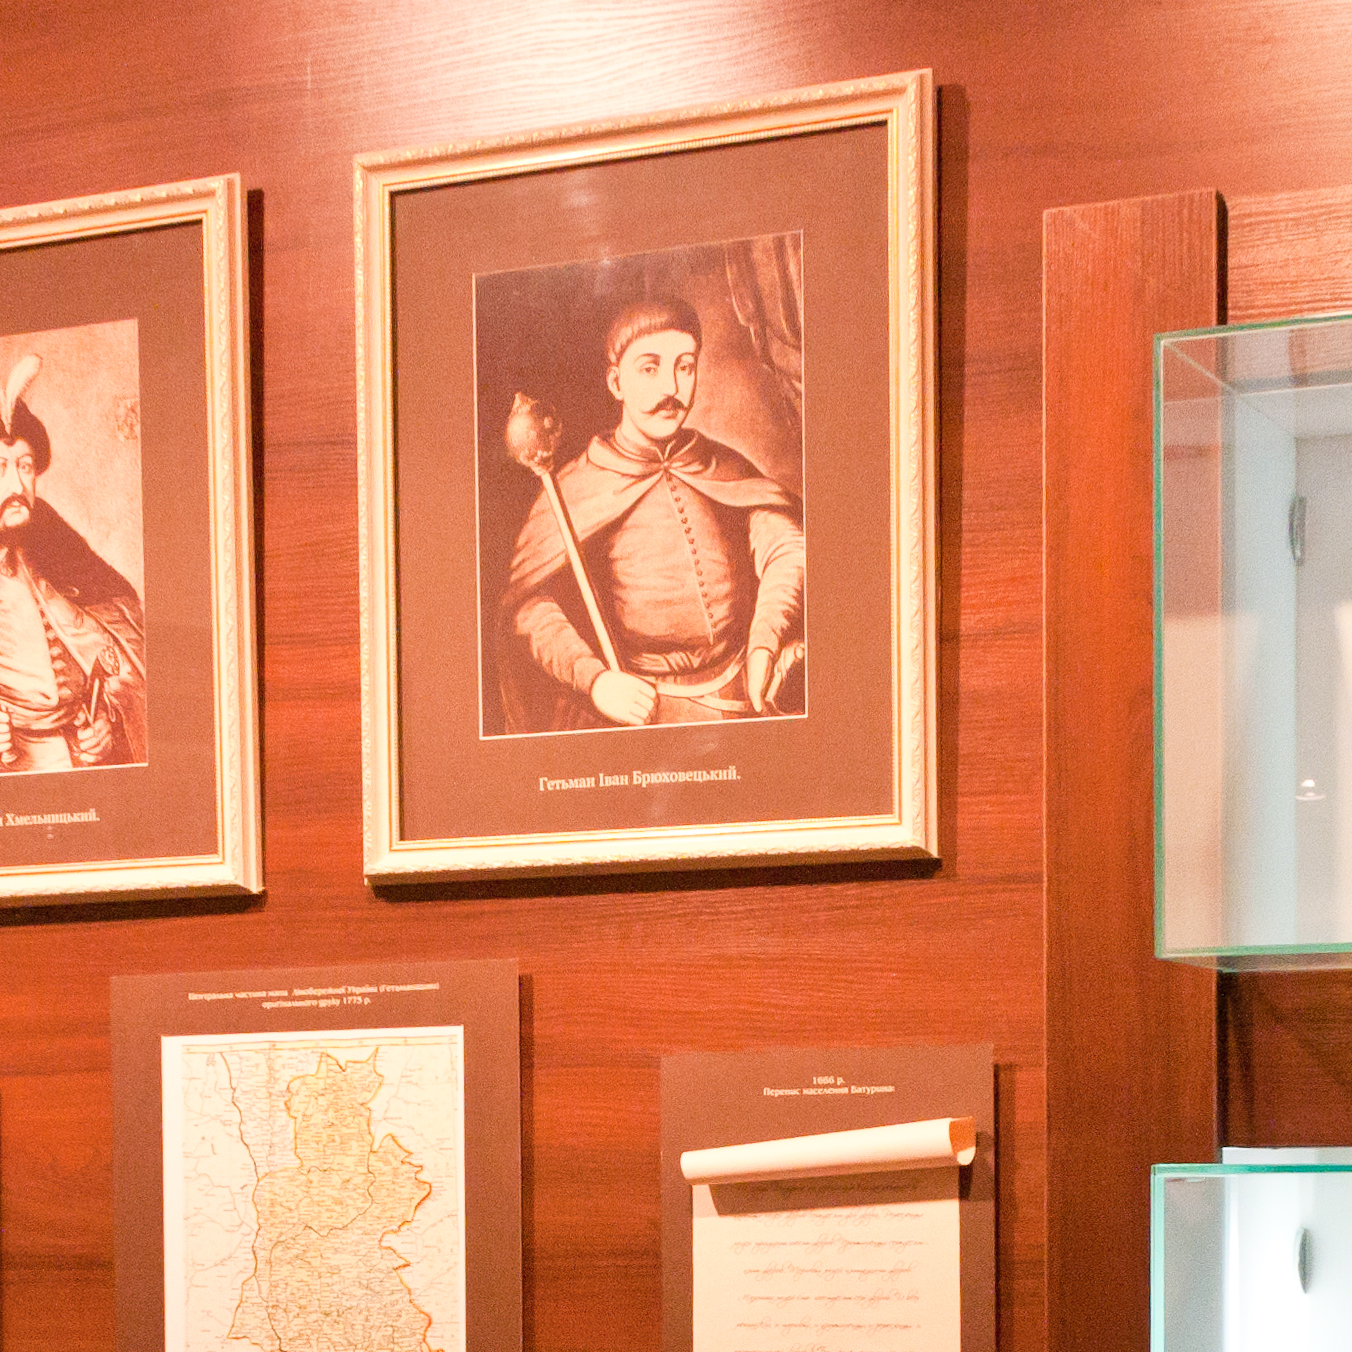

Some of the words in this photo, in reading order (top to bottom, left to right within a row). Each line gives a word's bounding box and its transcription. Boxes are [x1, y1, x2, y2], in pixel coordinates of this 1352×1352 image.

[539, 776, 595, 791] Гетьман
[598, 773, 629, 787] Іван
[632, 765, 742, 787] Брюховецький.
[5, 808, 101, 827] Хмельницький.
